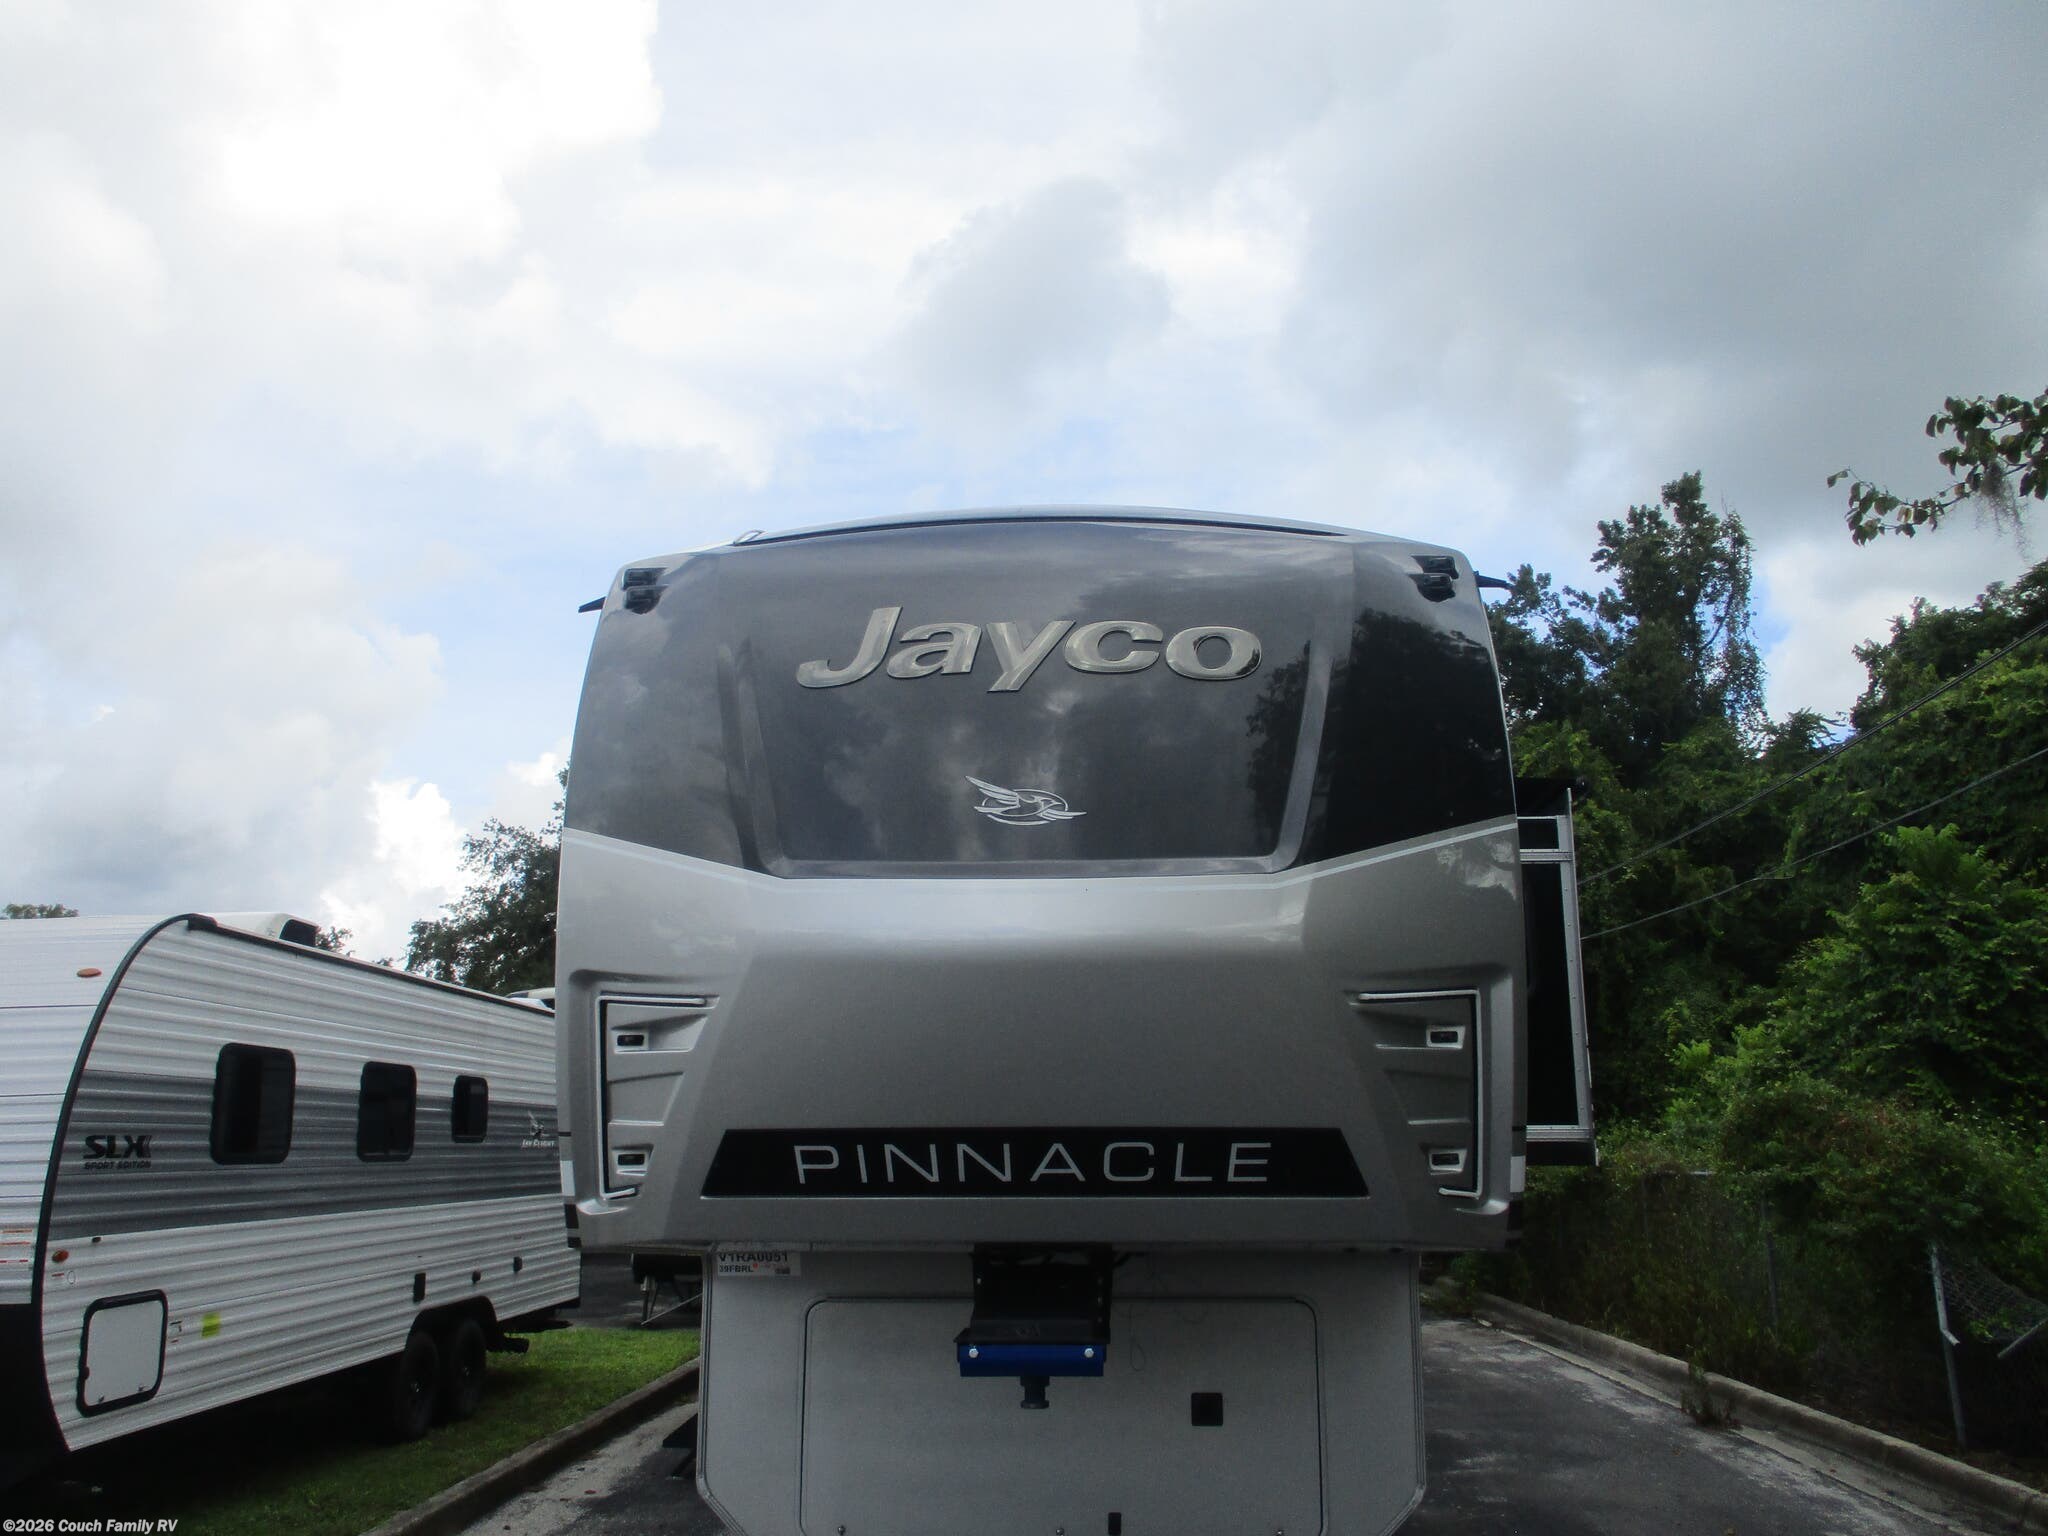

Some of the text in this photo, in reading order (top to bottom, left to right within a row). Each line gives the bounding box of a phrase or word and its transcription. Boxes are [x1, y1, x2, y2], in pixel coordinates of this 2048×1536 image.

[796, 605, 1262, 693] Jayco
[83, 1135, 152, 1158] SLX
[794, 1141, 1272, 1185] PINNACLE
[84, 1161, 114, 1170] SPORT
